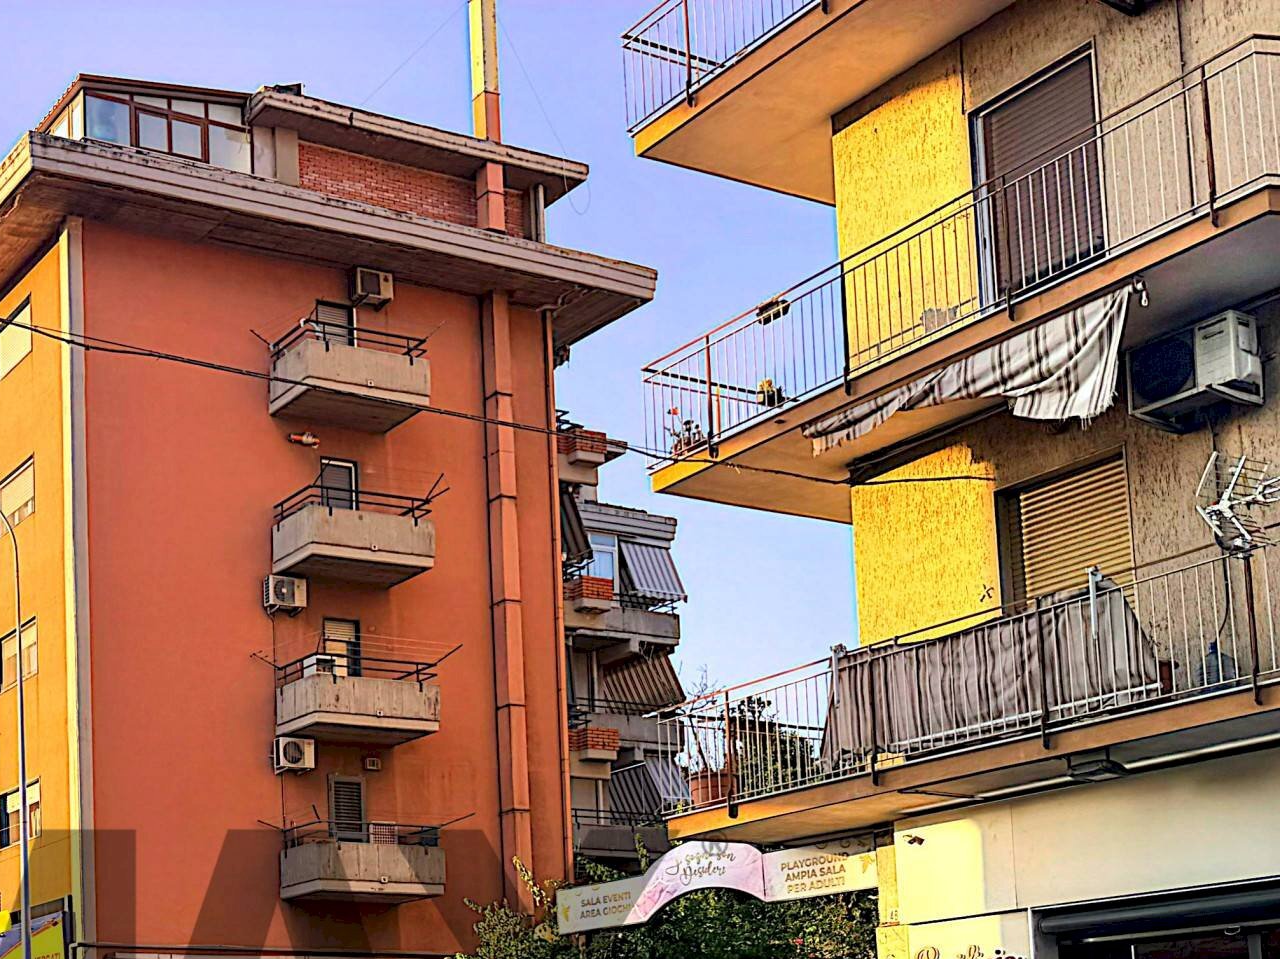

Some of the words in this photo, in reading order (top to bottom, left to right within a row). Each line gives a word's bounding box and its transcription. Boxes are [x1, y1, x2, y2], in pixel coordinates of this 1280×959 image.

[780, 852, 850, 872] PLAYGROUND
[784, 868, 819, 882] AMPIA
[819, 864, 847, 877] SALA
[787, 882, 808, 894] PER
[809, 876, 846, 891] ADULTI
[580, 896, 601, 907] SALA
[602, 890, 632, 904] EVENTI
[580, 908, 601, 919] AREA
